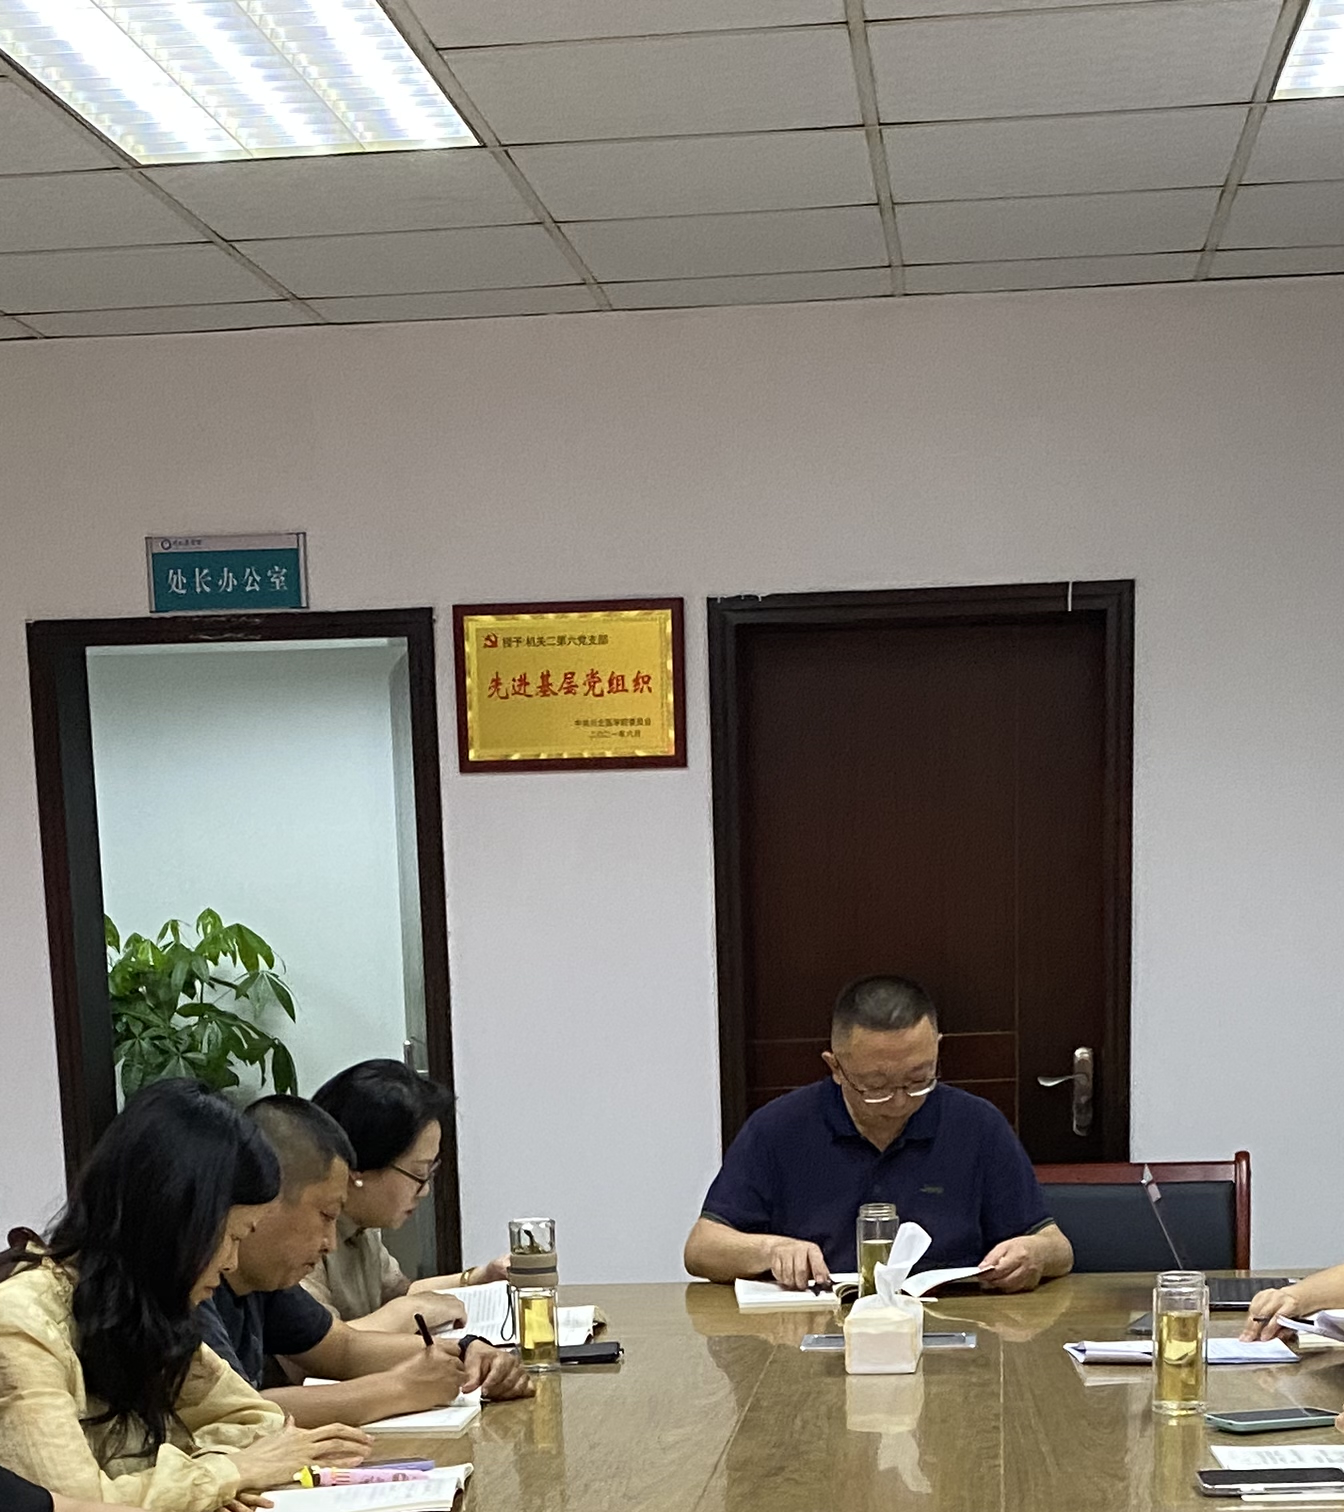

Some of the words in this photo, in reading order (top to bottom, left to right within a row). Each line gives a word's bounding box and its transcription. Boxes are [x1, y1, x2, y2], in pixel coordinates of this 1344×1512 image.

[168, 566, 288, 594] 处长办公室
[487, 668, 654, 700] 先进基层党组织
